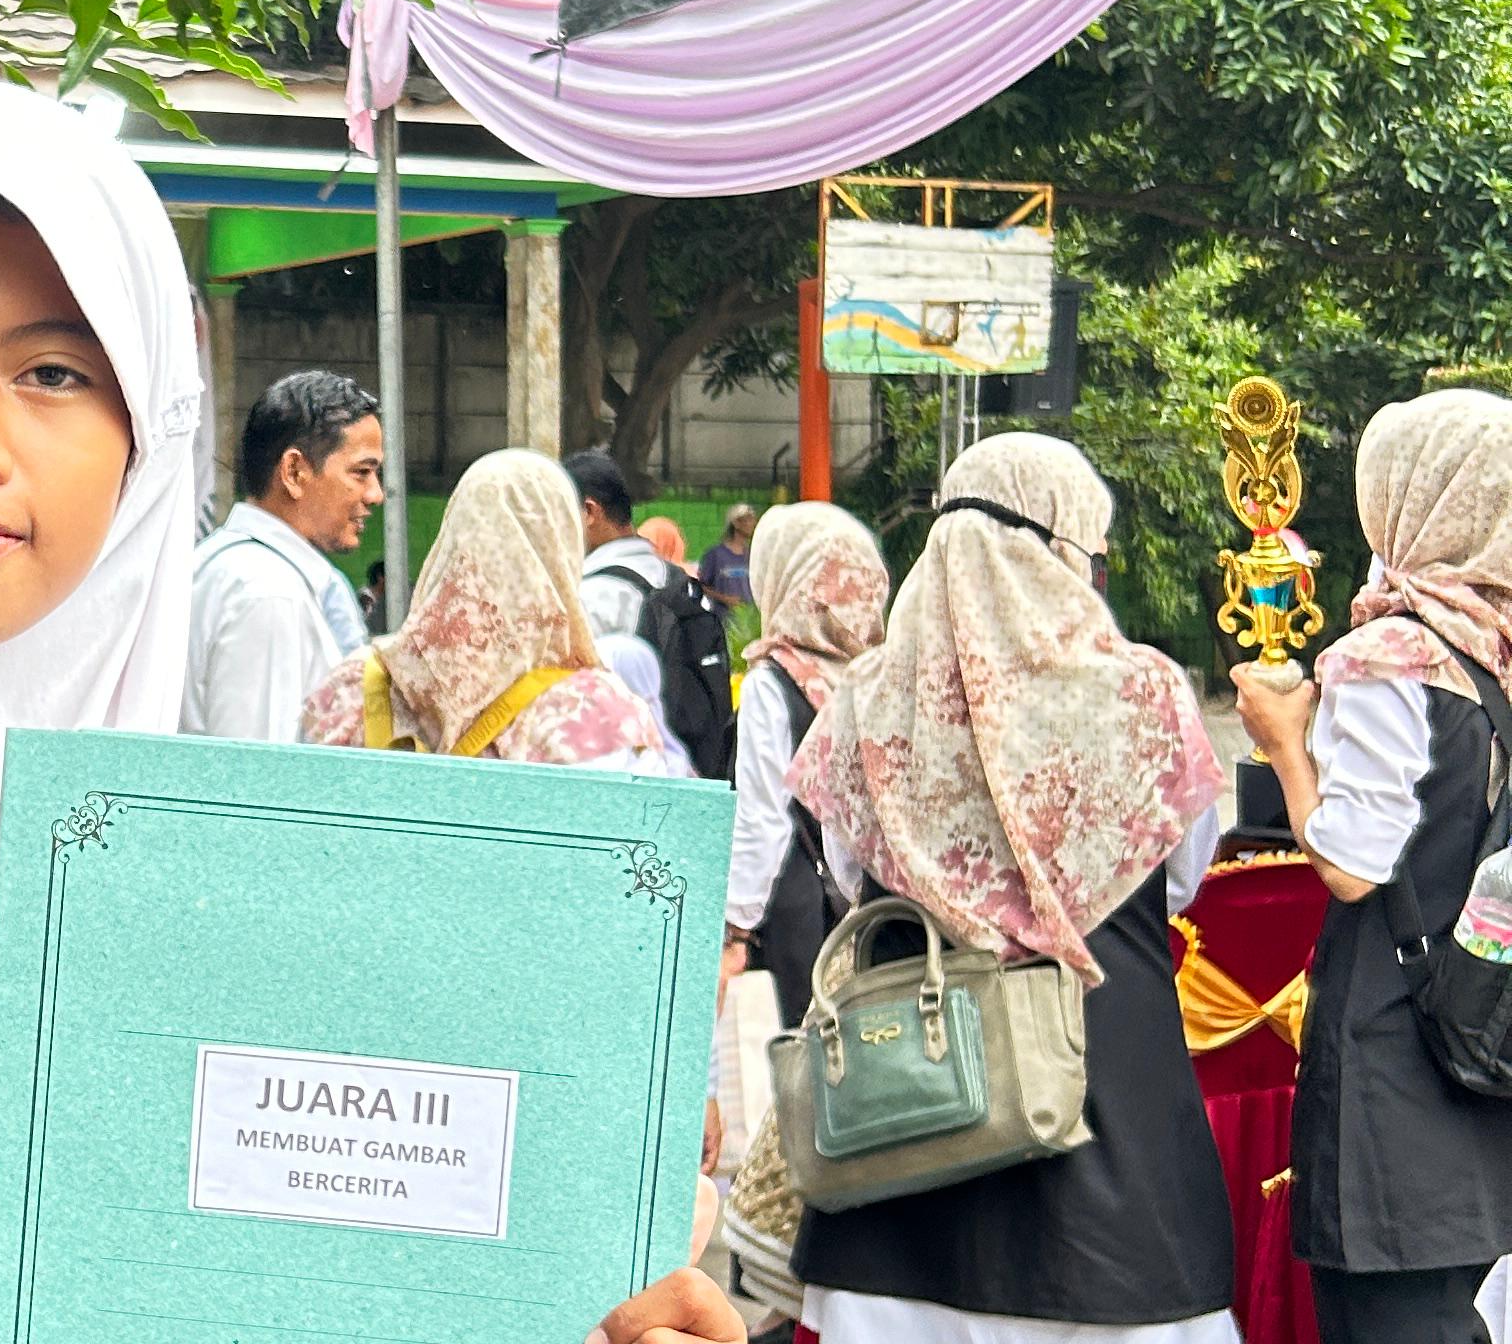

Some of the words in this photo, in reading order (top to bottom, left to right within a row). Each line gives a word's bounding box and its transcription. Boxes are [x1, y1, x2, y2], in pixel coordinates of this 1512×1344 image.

[255, 1077, 398, 1122] JUARA
[412, 1091, 451, 1127] III
[236, 1128, 358, 1158] MEMBUAT
[363, 1140, 467, 1168] GAMBAR
[287, 1170, 409, 1199] BERCERITA
